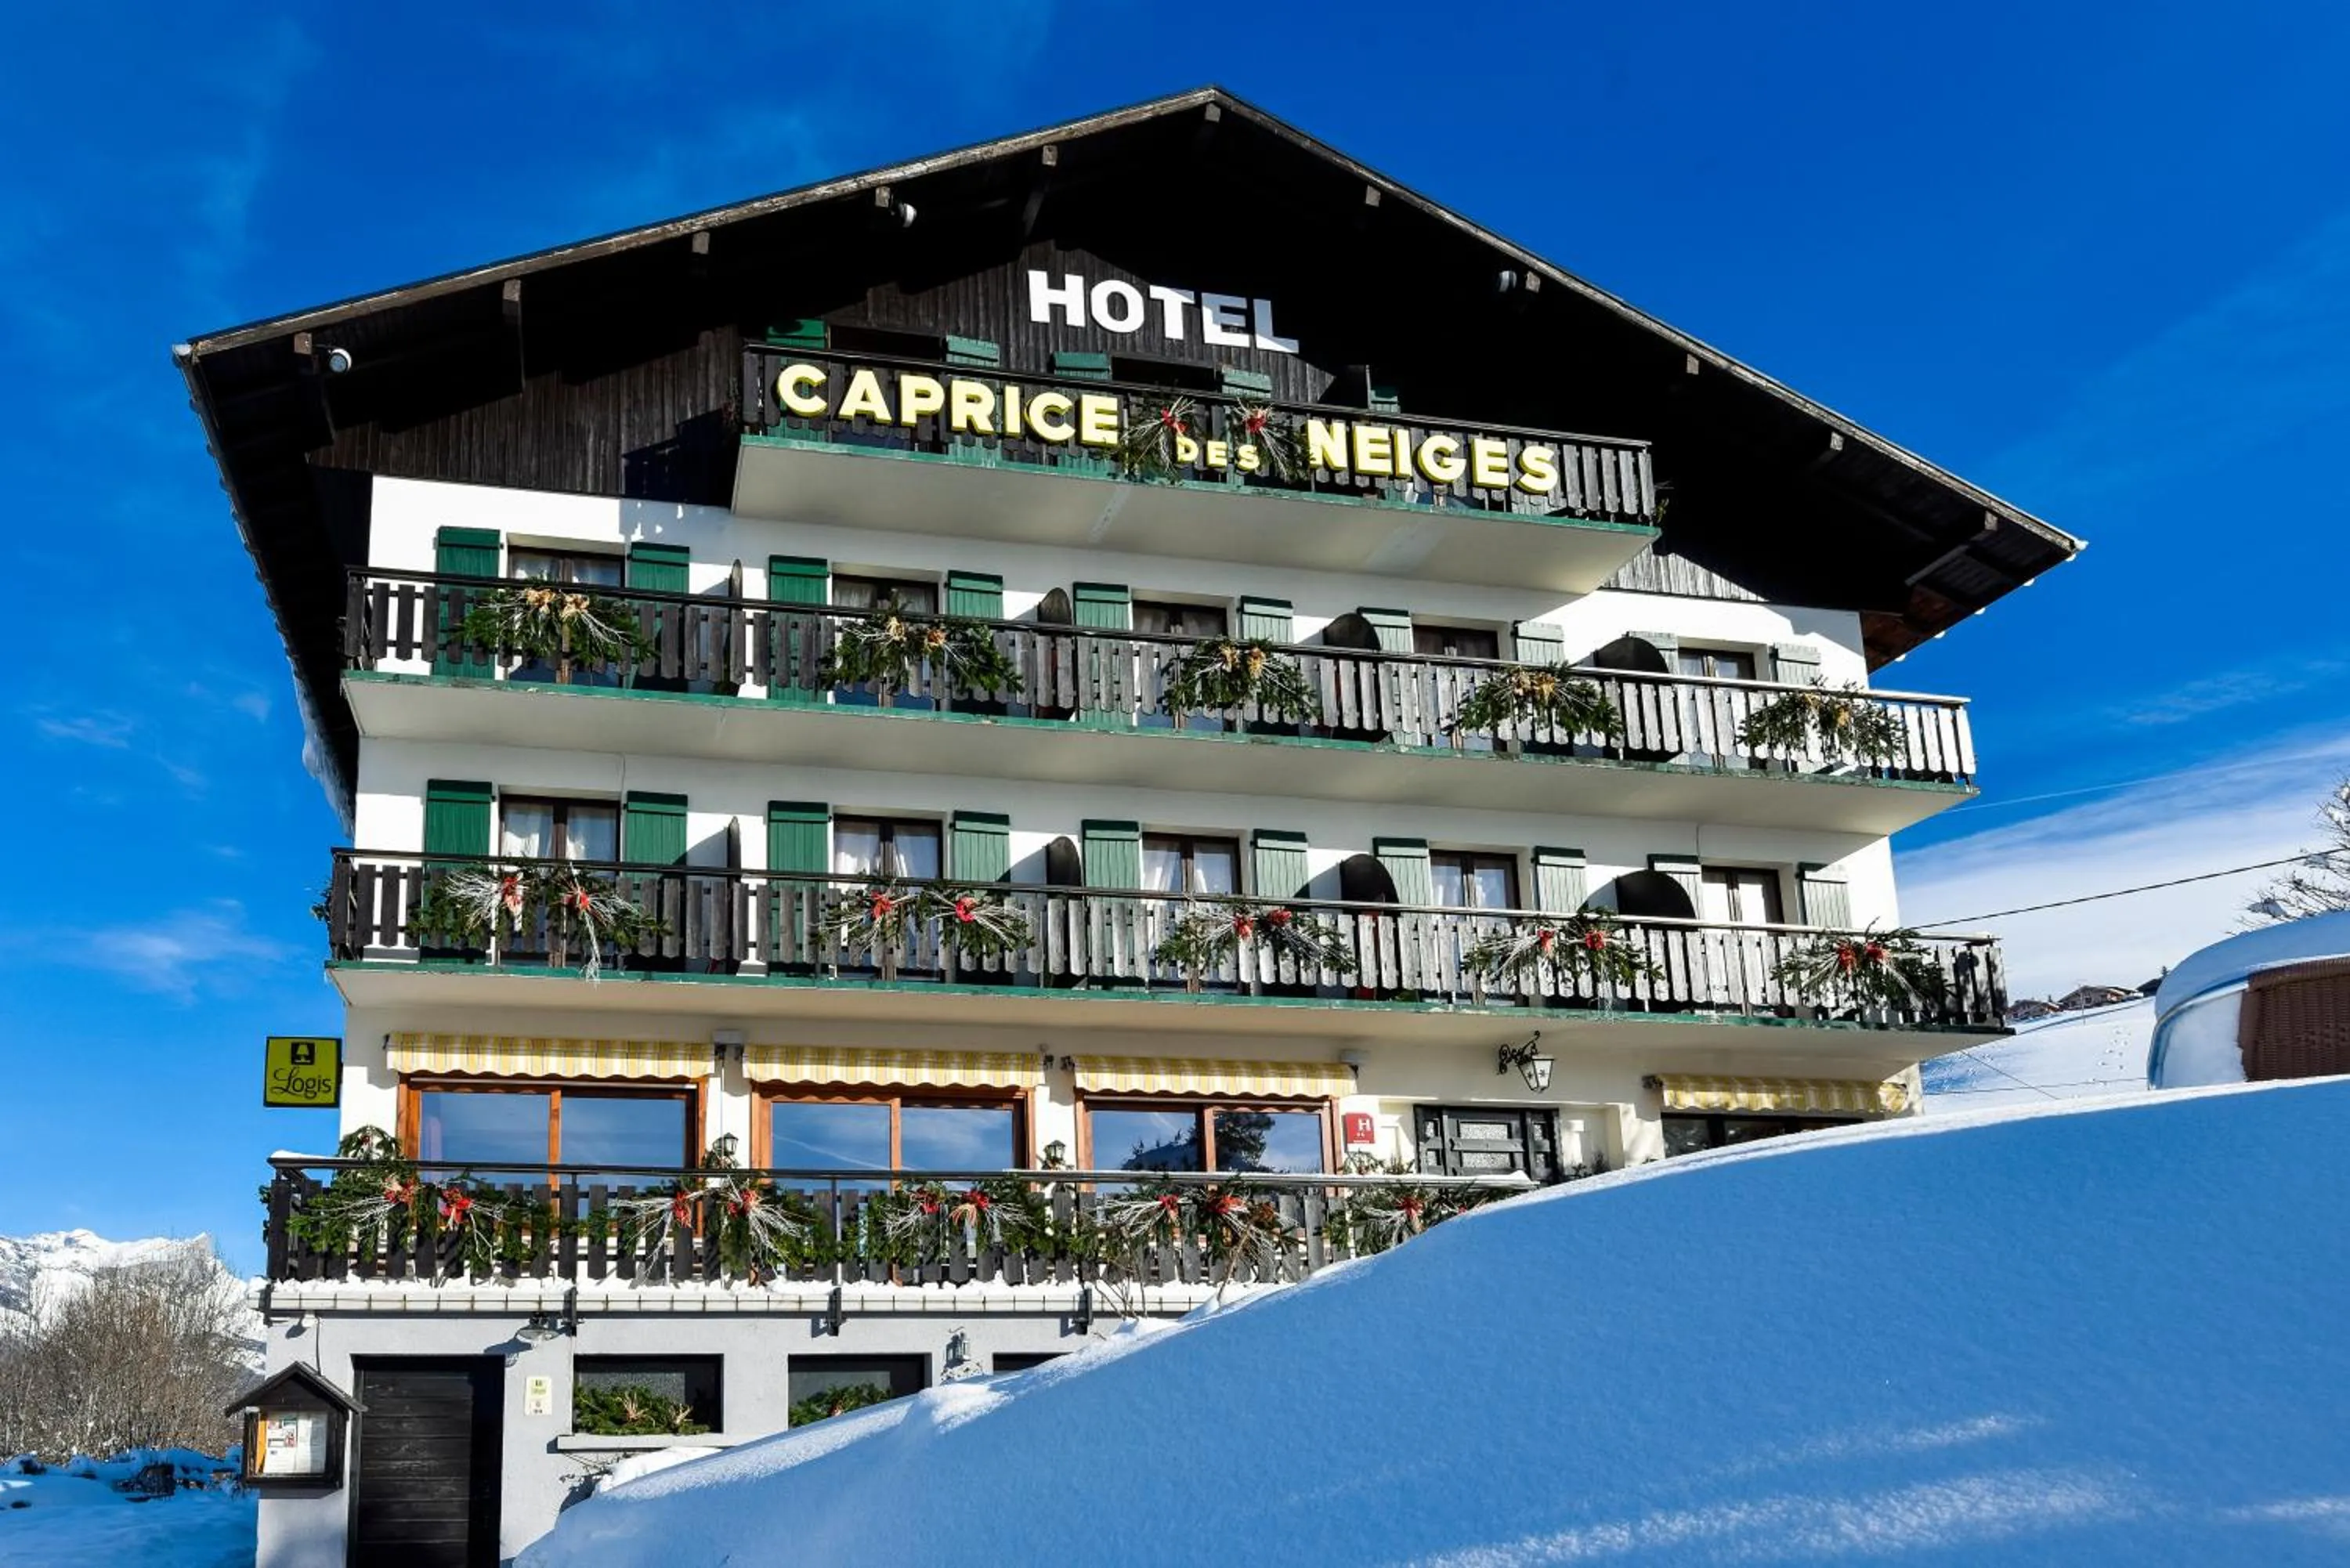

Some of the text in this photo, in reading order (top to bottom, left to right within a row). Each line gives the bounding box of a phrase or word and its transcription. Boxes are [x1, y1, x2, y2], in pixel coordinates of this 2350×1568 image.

[1028, 269, 1299, 353] HOTEL
[776, 364, 1558, 495] CAPRICE DES NEIGES
[270, 1066, 331, 1099] Logis
[1358, 1118, 1372, 1132] H
